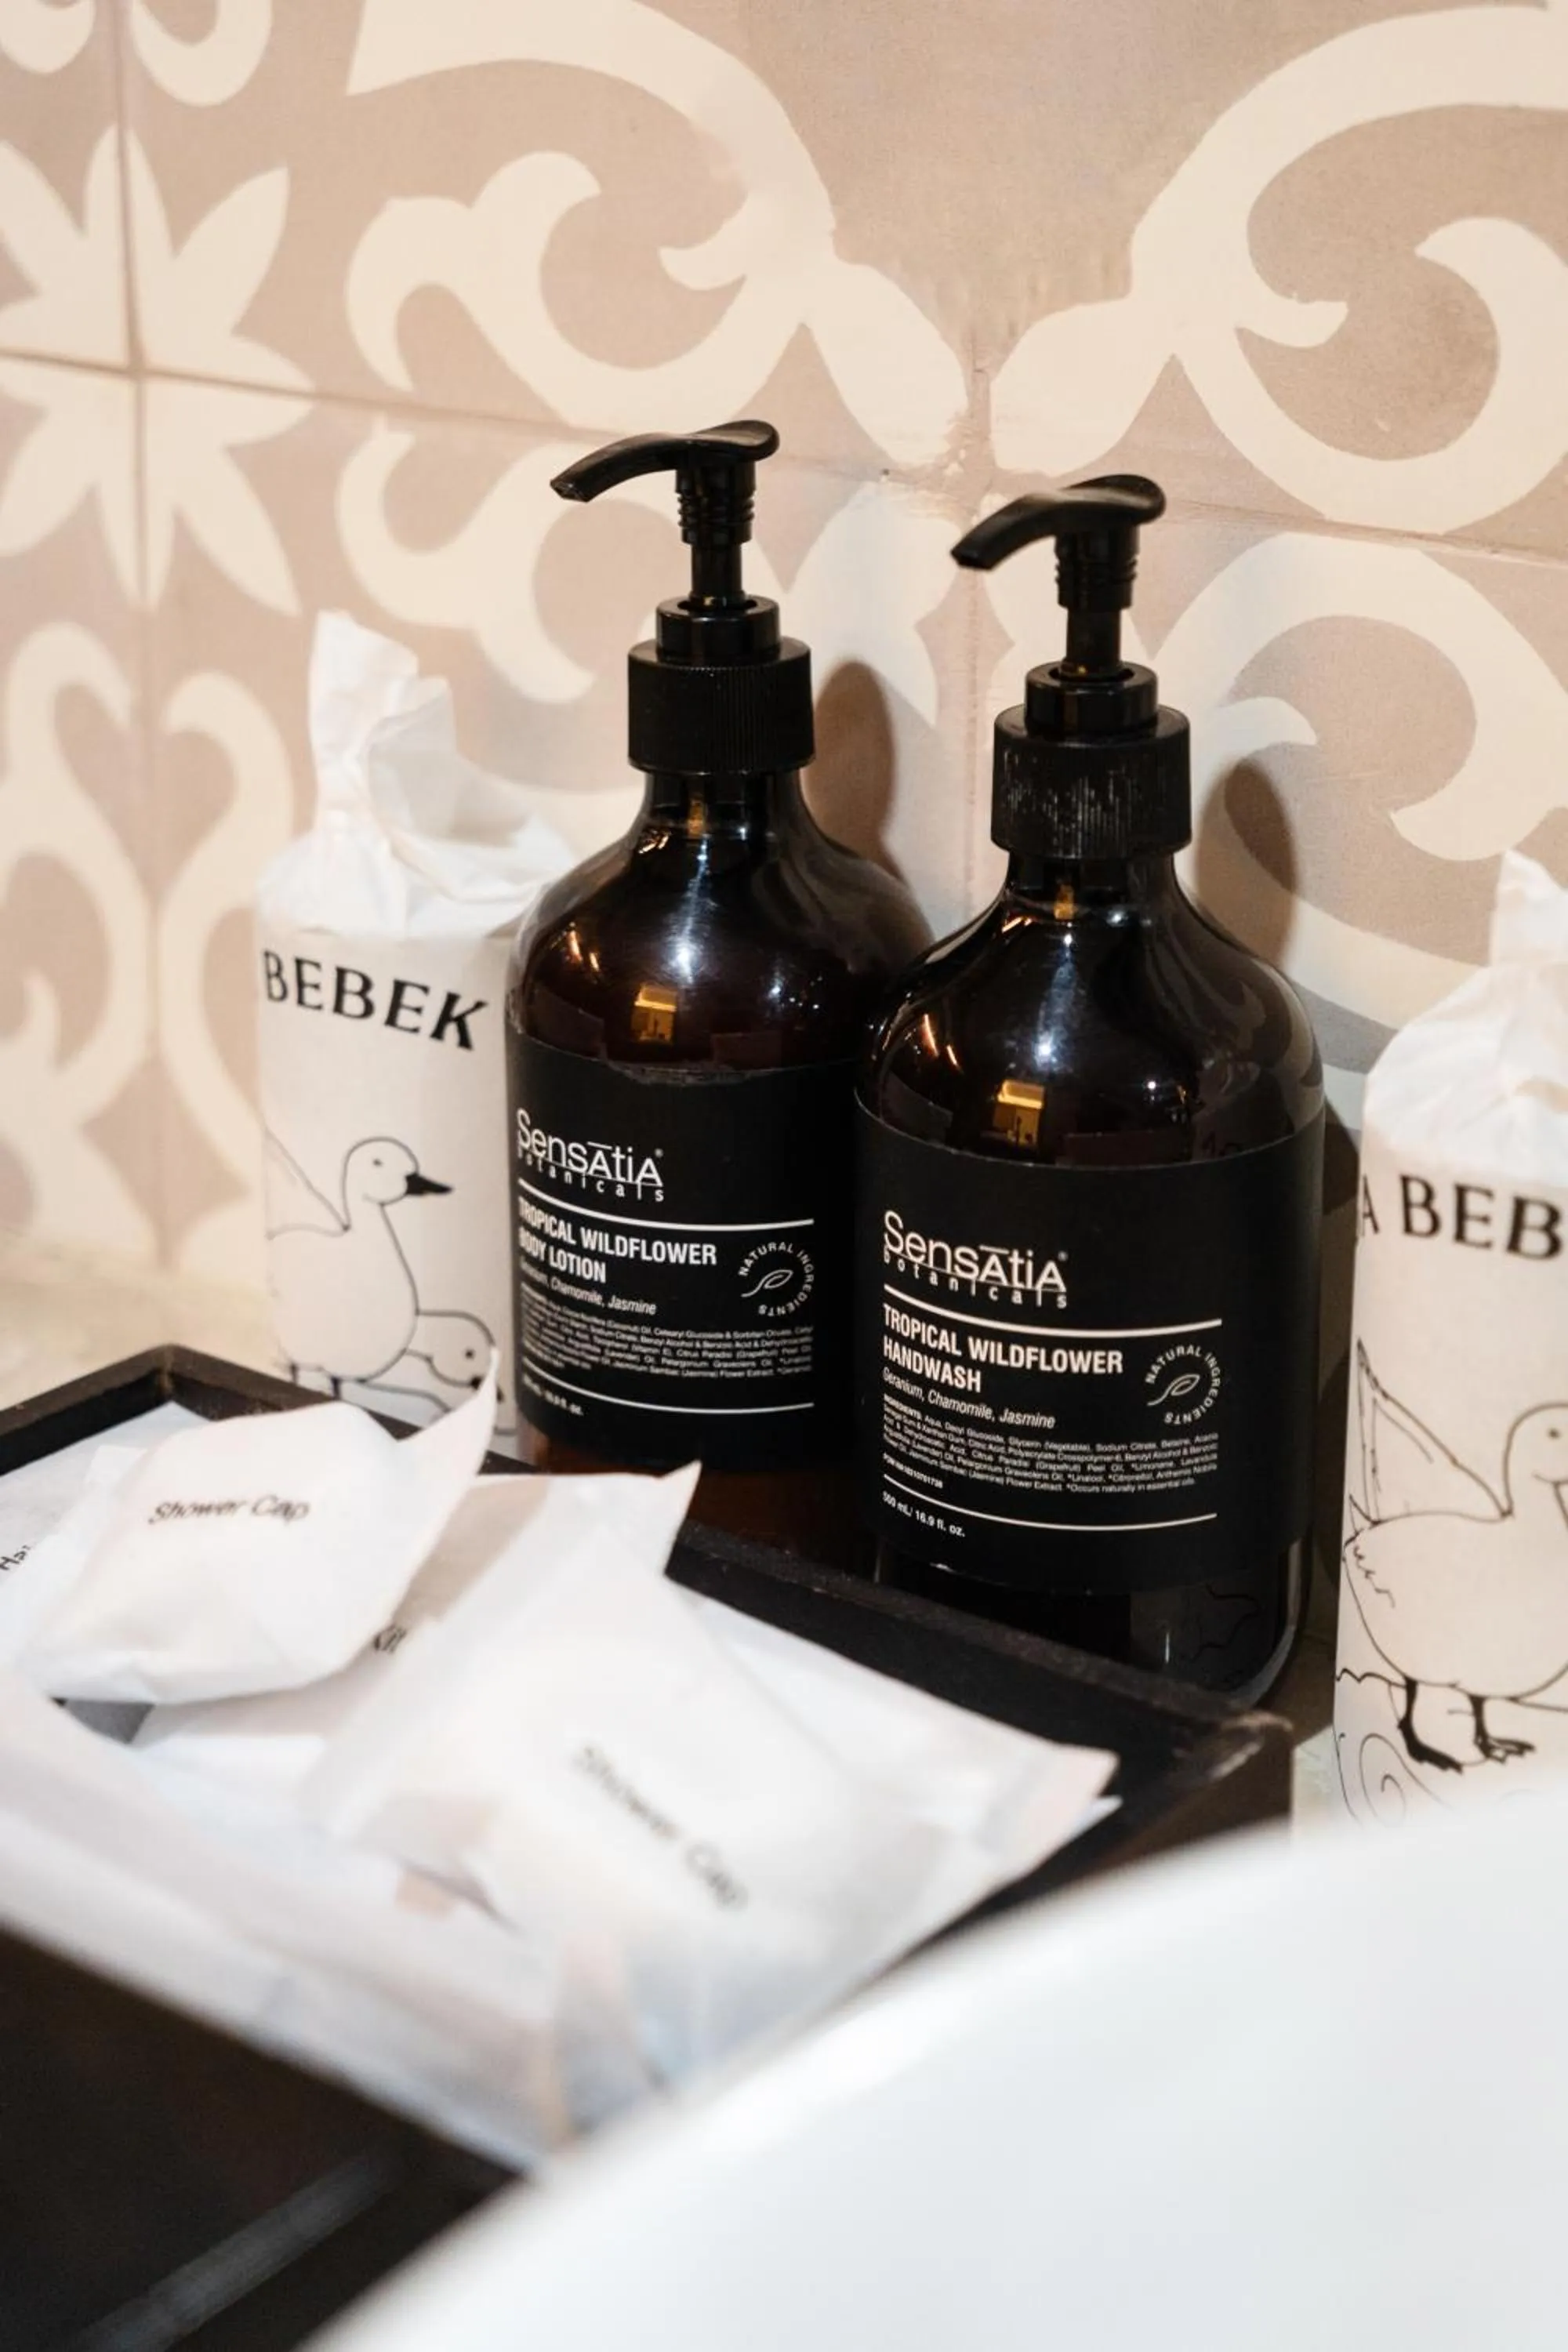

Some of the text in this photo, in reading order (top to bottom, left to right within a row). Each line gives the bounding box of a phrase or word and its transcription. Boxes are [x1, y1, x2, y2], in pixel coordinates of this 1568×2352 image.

[262, 947, 488, 1051] BEBEK
[518, 1196, 717, 1265] TROPICAL WILDFLOWER
[1399, 1174, 1563, 1261] BEB
[518, 1226, 606, 1283] BODY LOTION
[738, 1242, 815, 1317] NATURAL INGREDIENTS
[883, 1244, 1067, 1308] botanicals
[608, 1295, 657, 1315] Jasmine
[884, 1303, 1123, 1374] TROPICAL WILDFLOWER
[884, 1335, 981, 1393] HANDWASH
[883, 1367, 1055, 1430] Geranium, Chamomile, Jasmine
[1145, 1345, 1221, 1425] NATURAL INGREDIENTS
[147, 1494, 310, 1524] Shower Cap
[949, 1525, 965, 1537] oz.
